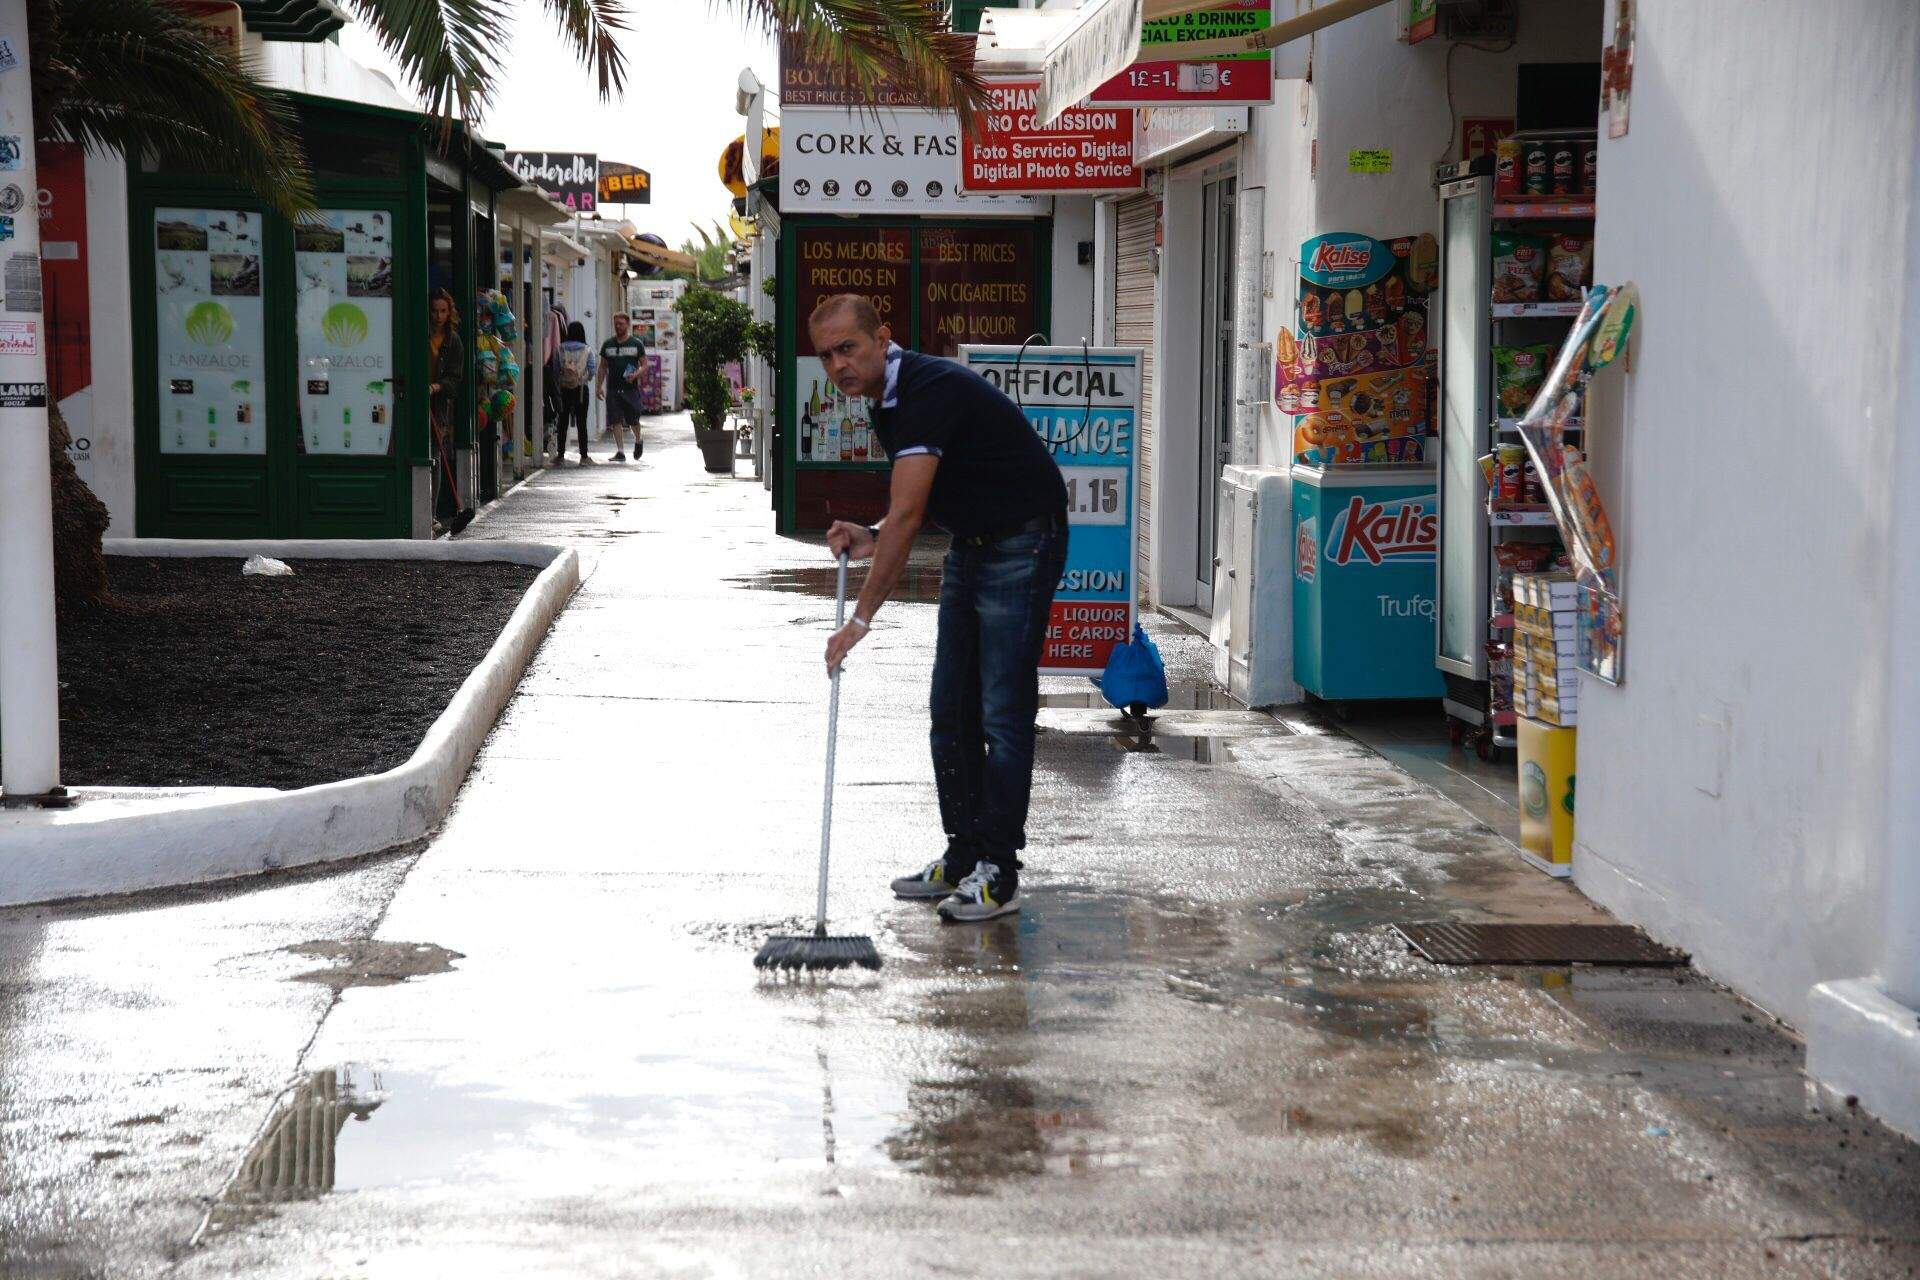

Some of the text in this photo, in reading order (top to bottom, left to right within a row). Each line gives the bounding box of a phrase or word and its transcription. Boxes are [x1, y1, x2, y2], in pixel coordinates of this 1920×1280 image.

[1184, 13, 1195, 25] &
[1199, 12, 1256, 25] DRINKS
[1193, 68, 1214, 86] 15
[1219, 69, 1232, 87] €
[785, 91, 811, 102] BEST
[987, 115, 1013, 132] NO
[796, 133, 875, 155] CORK
[882, 134, 905, 157] &
[973, 143, 1007, 160] Foto
[1012, 142, 1077, 159] Servicio
[1081, 140, 1132, 161] Digital
[973, 161, 1132, 182] Digital Photo Service
[803, 241, 905, 261] LOS MEJORES
[938, 243, 1016, 263] BEST PRICES
[1314, 240, 1371, 273] Kalise
[810, 267, 897, 287] PRECIOS EN
[927, 283, 1027, 303] ON CIGARETTES
[937, 316, 1017, 338] AND LIQUOR
[169, 353, 250, 368] LANZALOE
[304, 354, 385, 369] LANZALOE
[981, 369, 1125, 398] OFFICIAL
[1065, 478, 1118, 514] 1.15
[1063, 608, 1126, 623] LIQUOR
[1068, 626, 1126, 640] CARDS
[1048, 644, 1094, 659] HERE
